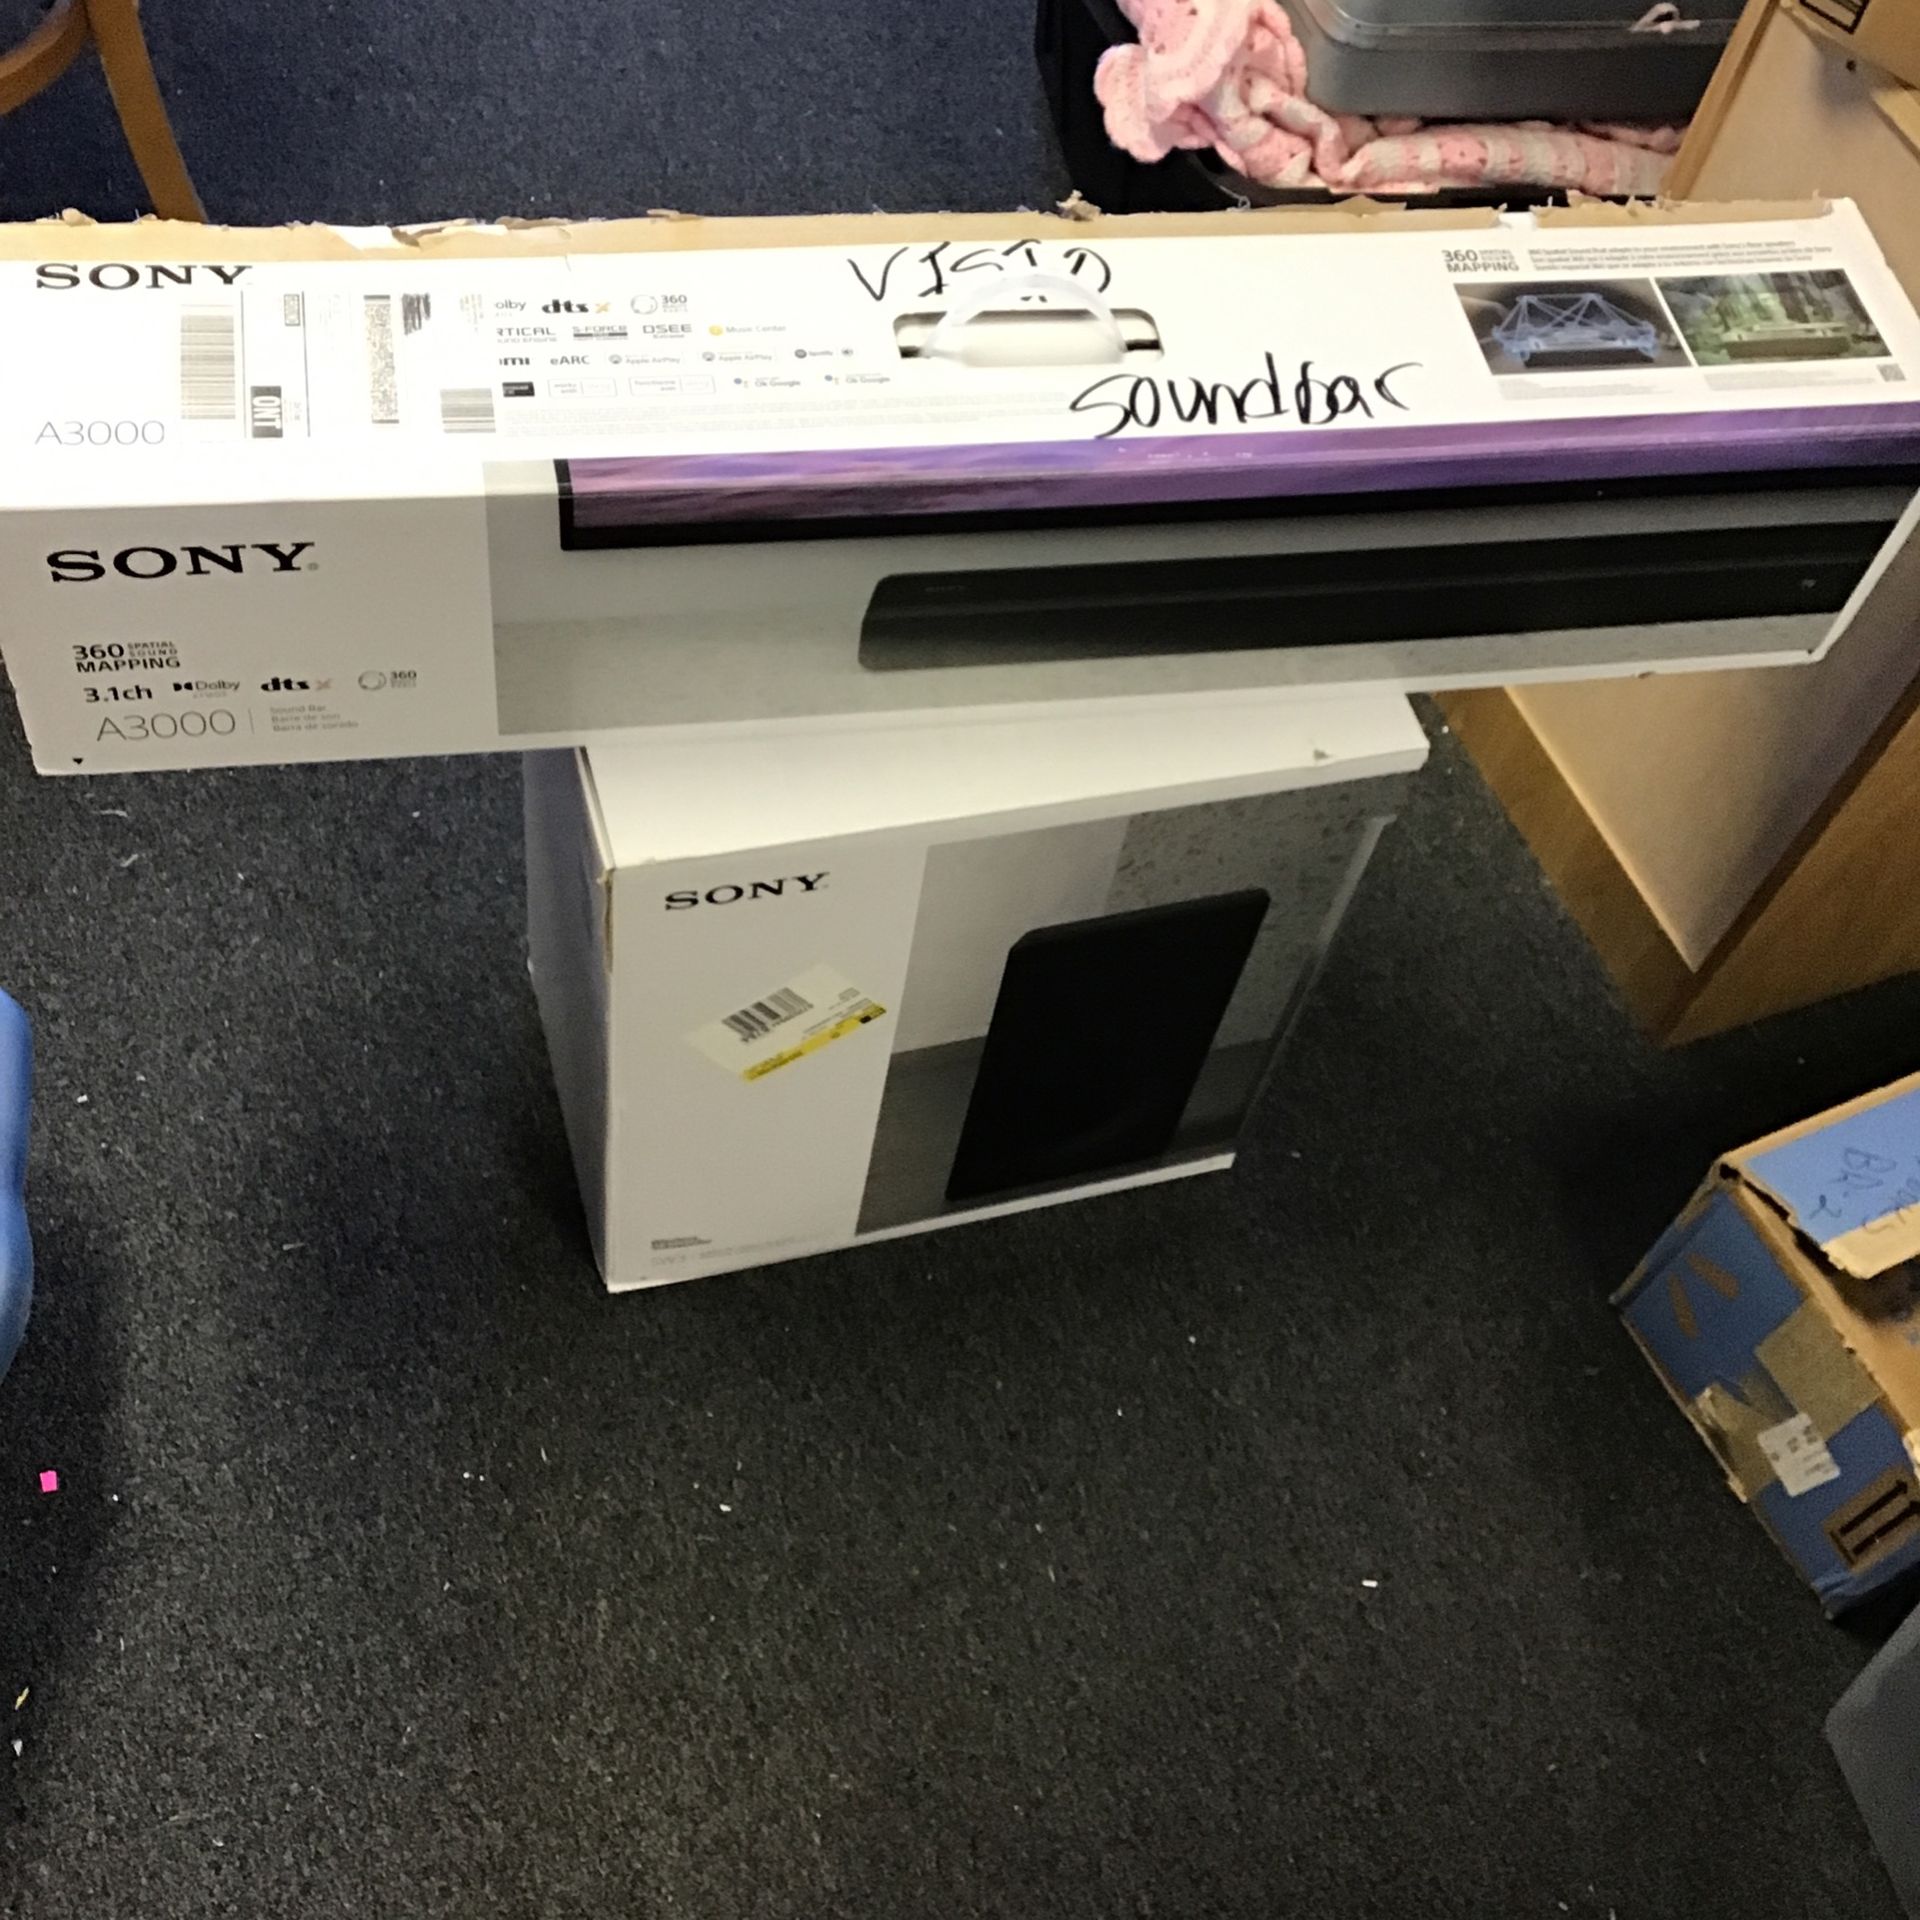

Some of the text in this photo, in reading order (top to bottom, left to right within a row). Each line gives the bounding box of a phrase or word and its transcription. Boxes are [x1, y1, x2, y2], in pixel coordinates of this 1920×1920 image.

[1441, 249, 1478, 262] 360
[1446, 261, 1519, 273] MAPPING
[36, 263, 253, 290] SONY
[494, 299, 526, 311] olby
[661, 294, 687, 304] 360
[542, 299, 589, 314] dts
[496, 326, 556, 336] RTICAL
[642, 323, 692, 334] DSEE
[550, 355, 590, 366] eARC
[35, 420, 165, 445] A3000
[46, 542, 315, 582] SONY
[72, 641, 175, 660] 360 SPATIAL
[129, 648, 178, 657] SOUND
[76, 656, 180, 672] MAPPING
[391, 670, 417, 680] 360
[195, 680, 240, 691] Dolby
[261, 677, 310, 691] dts
[83, 684, 152, 703] 3.1ch
[97, 709, 236, 741] A3000
[664, 872, 830, 911] SONY
